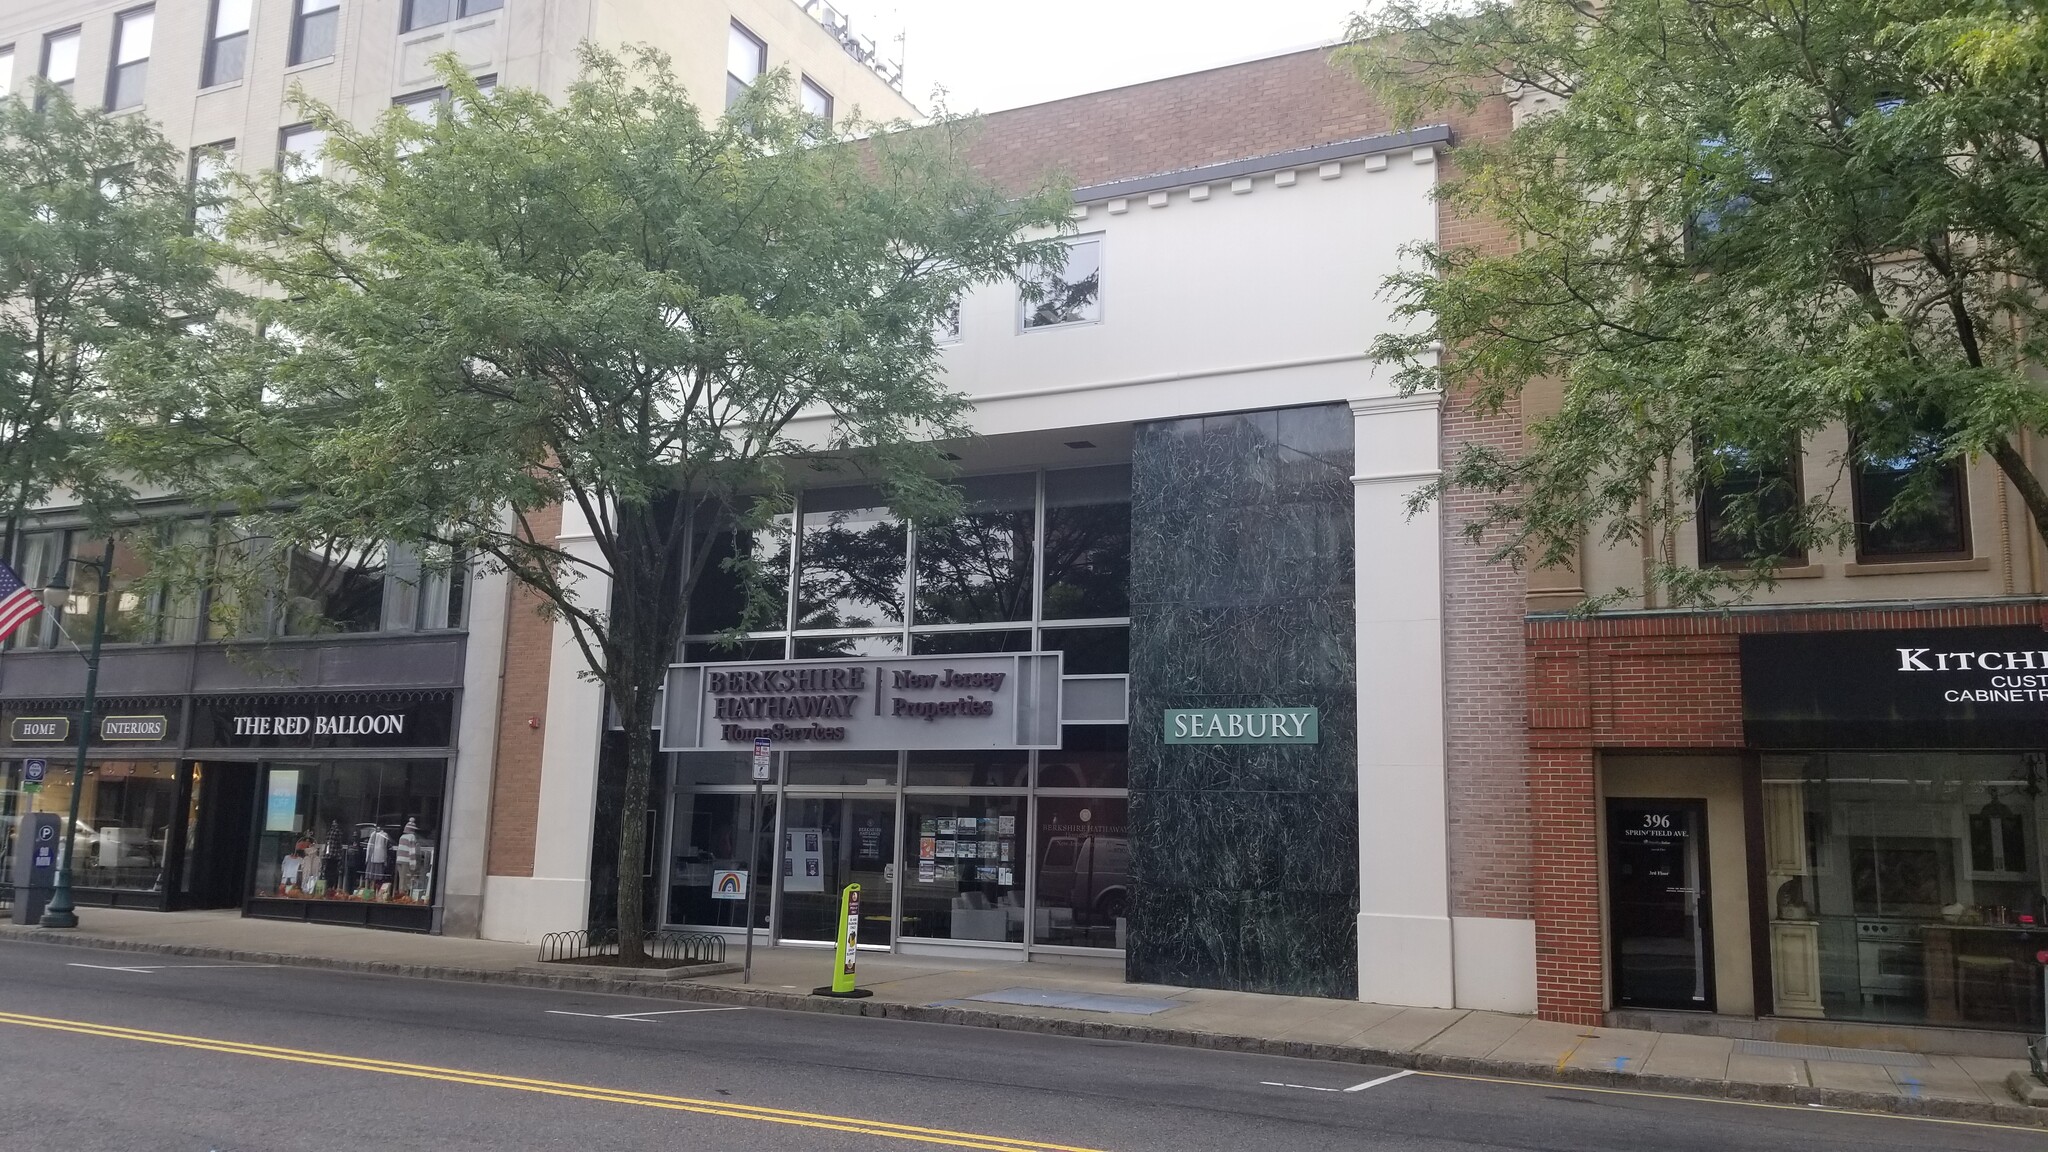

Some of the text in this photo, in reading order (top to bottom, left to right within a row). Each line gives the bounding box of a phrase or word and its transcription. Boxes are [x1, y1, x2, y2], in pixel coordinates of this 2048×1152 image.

[707, 667, 865, 693] BERKSHIRE
[891, 668, 1006, 692] New Jersey
[1991, 675, 2048, 688] CUST
[713, 694, 858, 719] HATHAWAY
[891, 695, 993, 722] Properties
[23, 722, 161, 735] HOME INTERIORS
[233, 714, 405, 735] THE RED BALLOON
[720, 722, 845, 741] HomeServices
[1174, 713, 1311, 738] SEABURY
[1643, 814, 1670, 828] 396
